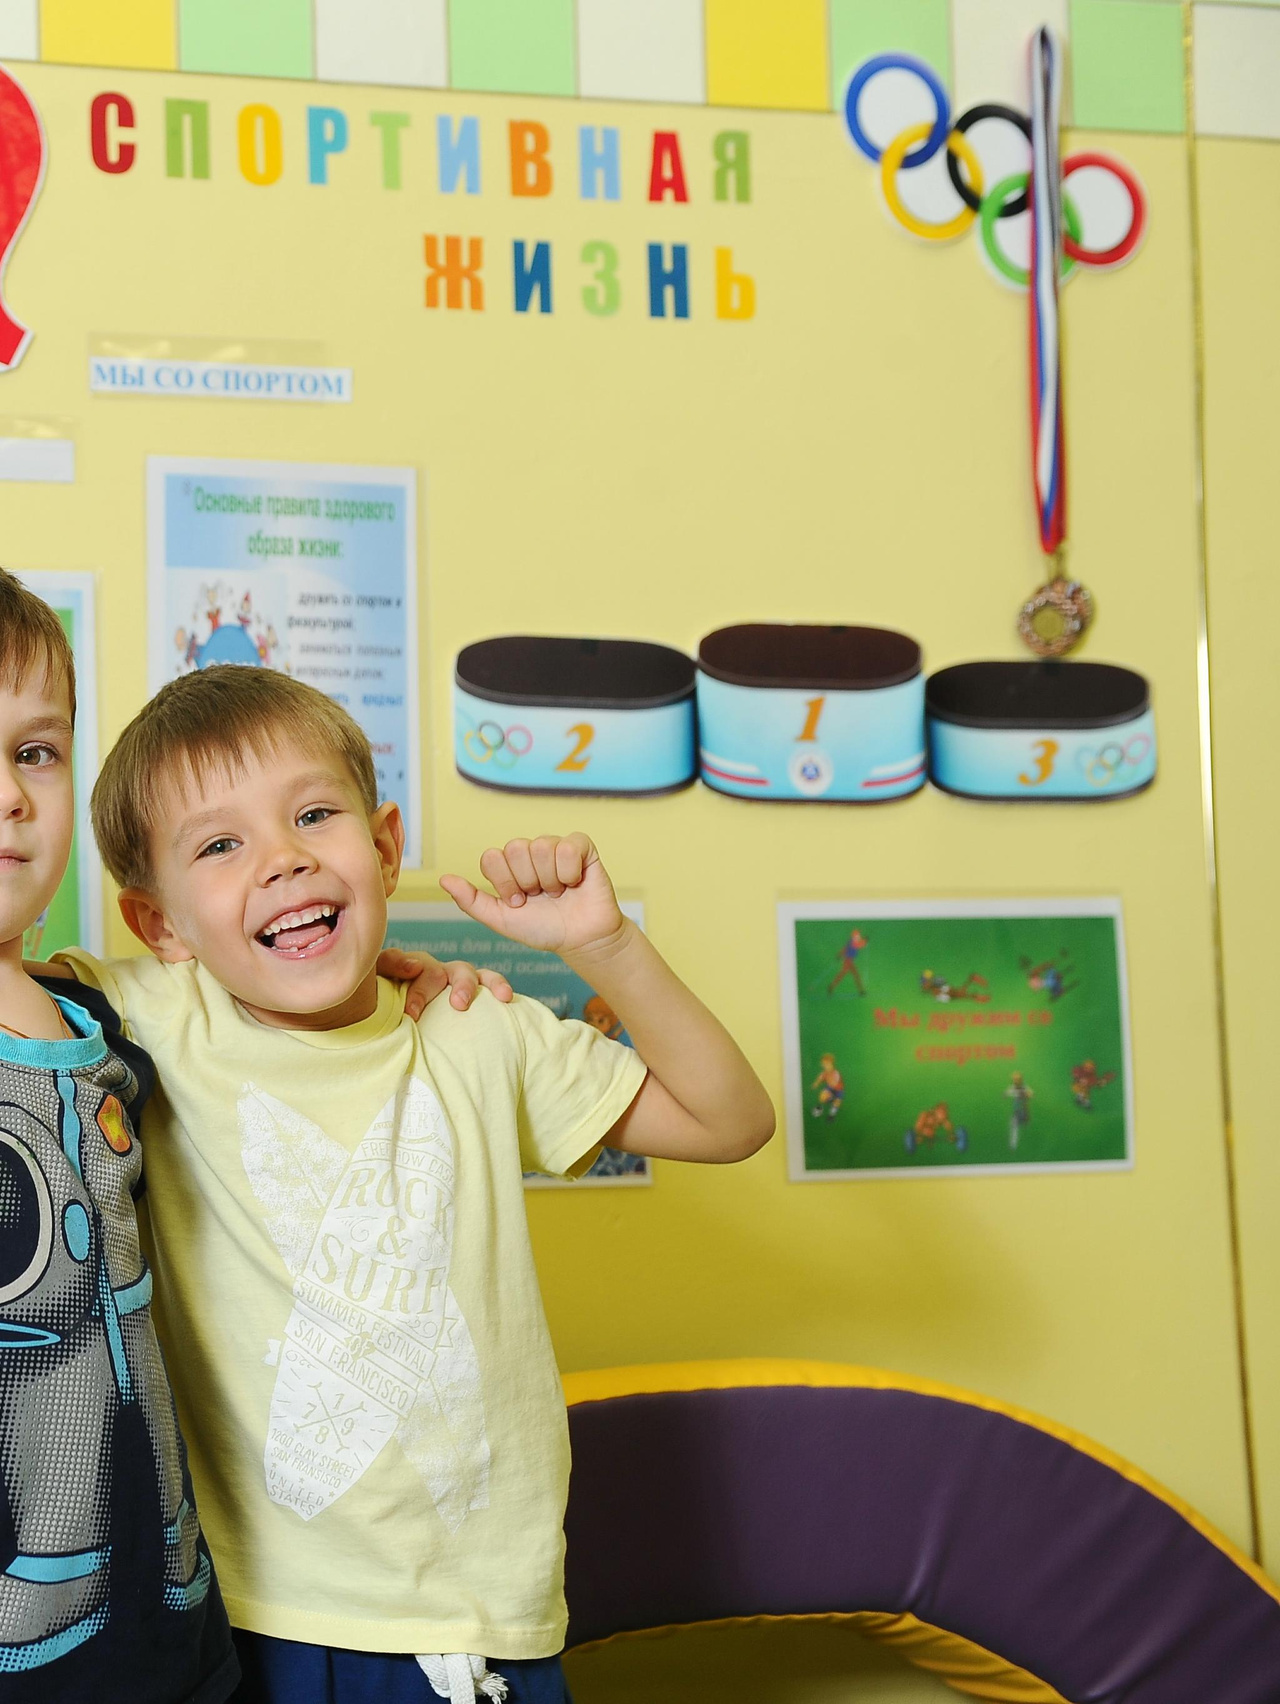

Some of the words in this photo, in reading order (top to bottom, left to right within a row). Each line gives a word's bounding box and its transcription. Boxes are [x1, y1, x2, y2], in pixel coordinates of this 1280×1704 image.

[89, 90, 753, 205] СПОРТИВНАЯ
[423, 233, 757, 322] ЖИЗНЬ
[94, 363, 145, 388] МЫ
[153, 366, 195, 389] СО
[202, 368, 343, 396] СПОРТОМ
[194, 485, 263, 515] Основные
[267, 495, 321, 519] правила
[325, 498, 395, 526] здорового
[248, 529, 293, 562] образа
[795, 696, 825, 741] 1
[555, 722, 596, 773] 2
[1018, 739, 1060, 786] 3
[873, 1006, 921, 1030] Мы
[334, 1167, 453, 1242] ROCK
[376, 1215, 413, 1260] &
[312, 1232, 447, 1315] SURF
[294, 1319, 327, 1355] SAN
[297, 1281, 368, 1333] SUMMER
[371, 1321, 429, 1374] FESTIVAL
[271, 1446, 291, 1464] SAN
[293, 1442, 319, 1463] CLAY
[319, 1455, 359, 1479] STREET
[268, 1469, 325, 1507] UNITED
[269, 1484, 316, 1516] STATES
